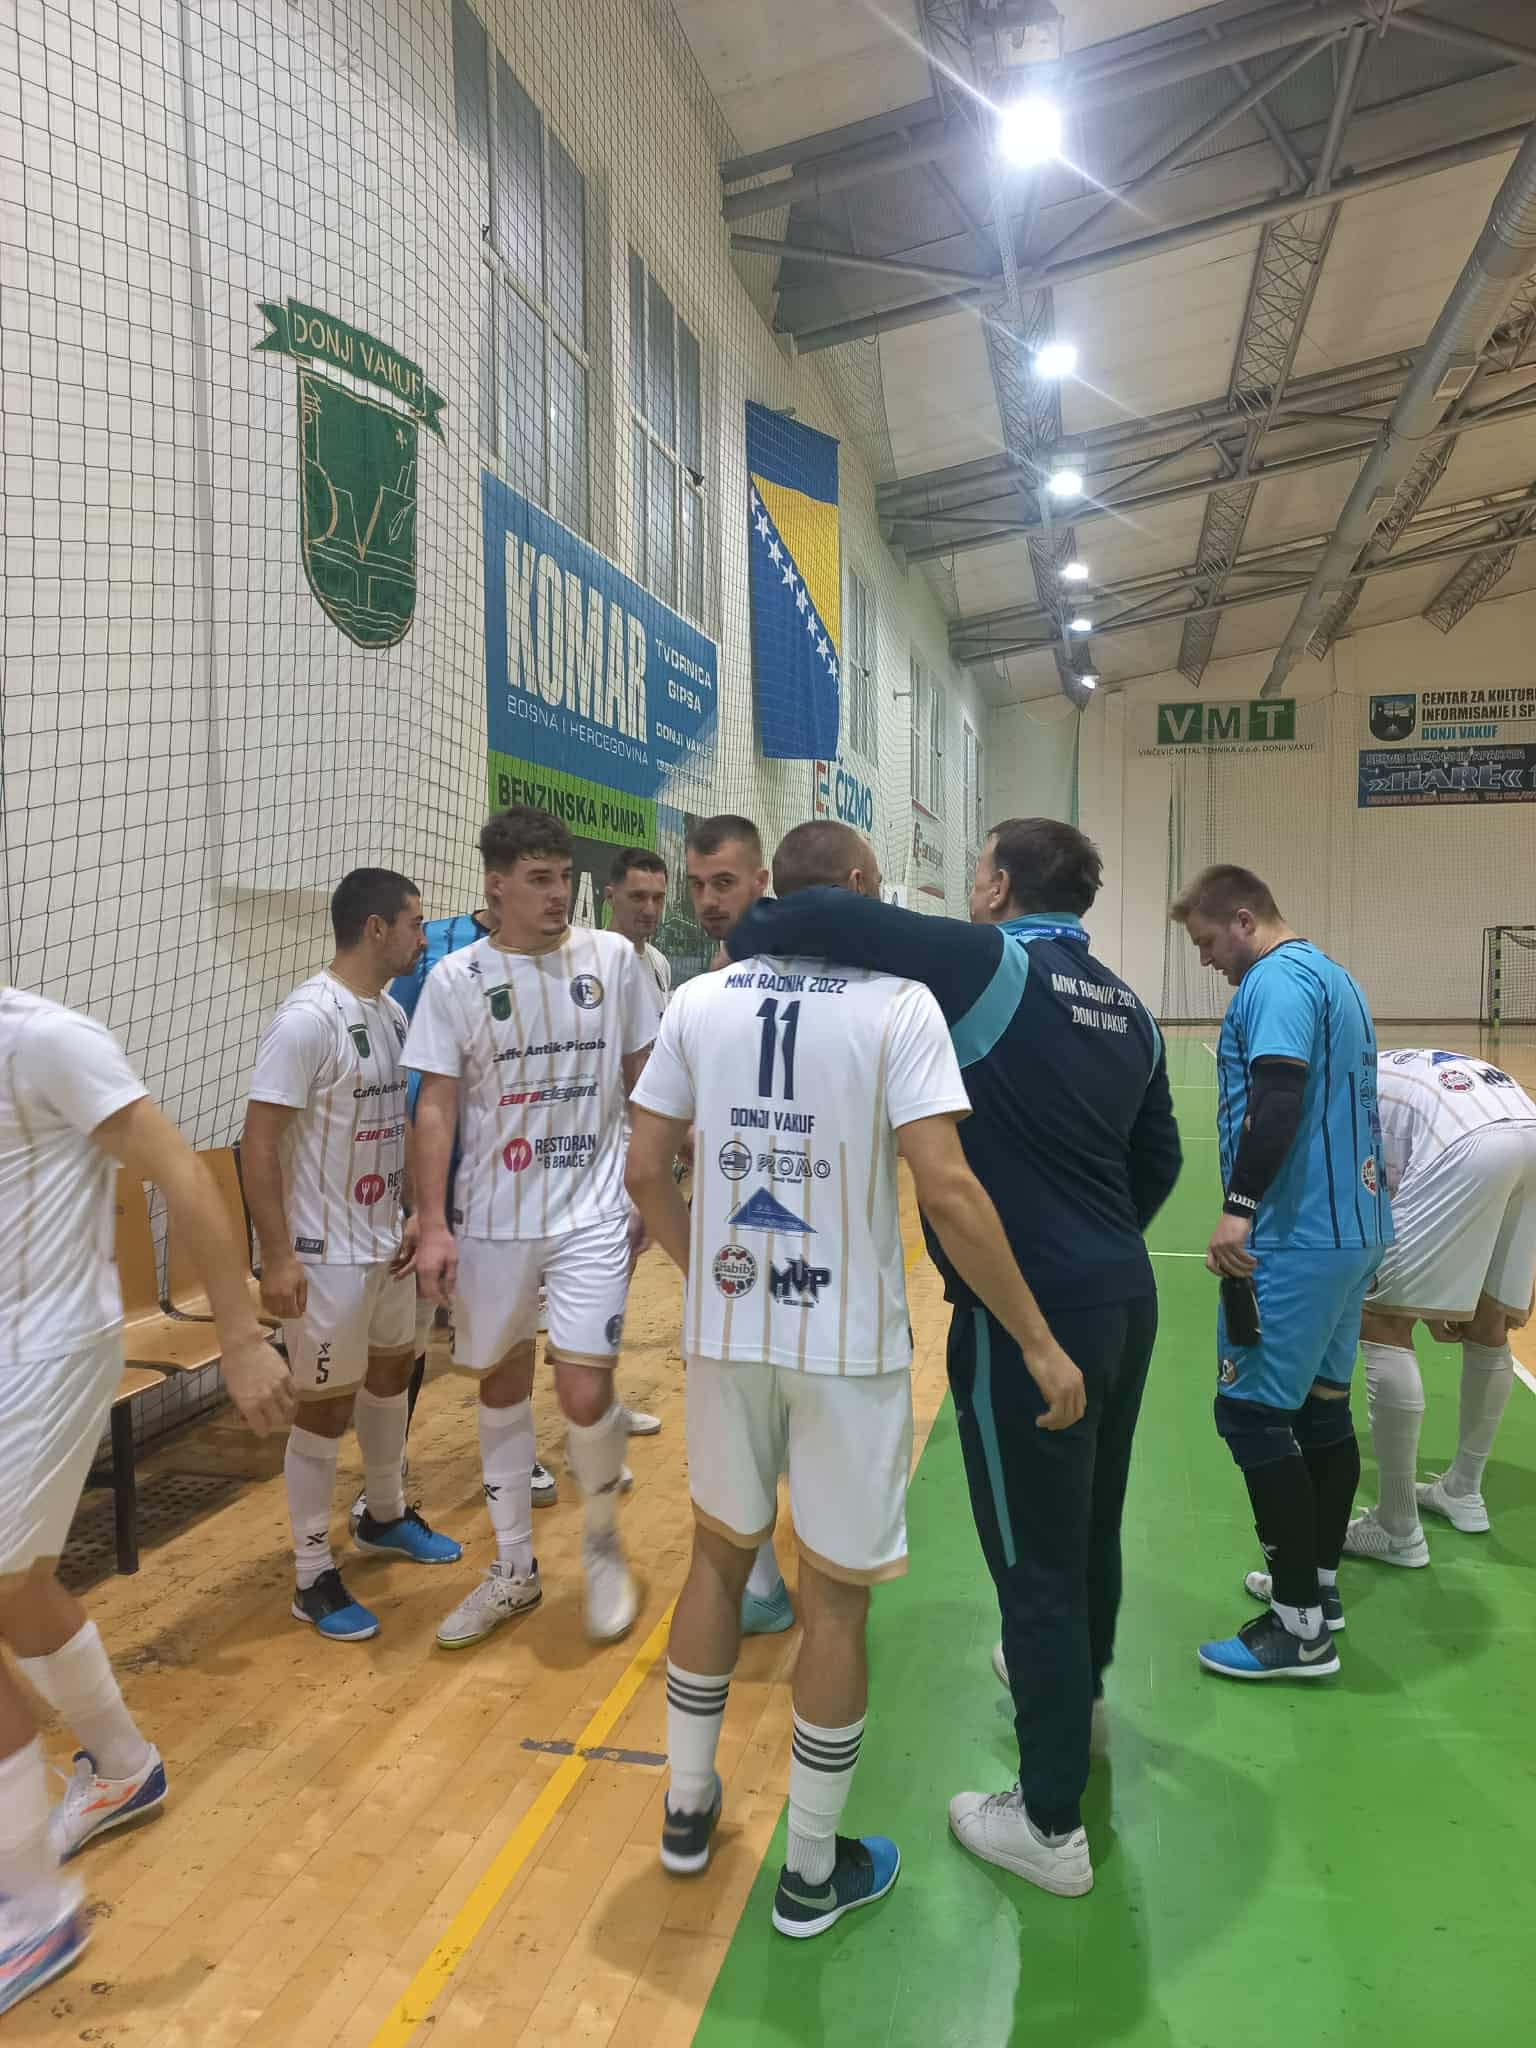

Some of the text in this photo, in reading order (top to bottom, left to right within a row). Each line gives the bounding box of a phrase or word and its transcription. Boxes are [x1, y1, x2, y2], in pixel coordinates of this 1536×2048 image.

[294, 312, 421, 399] DONJI VAKUF
[505, 529, 648, 744] KOMAR
[656, 637, 712, 690] TVORNICA
[668, 679, 702, 713] GIPSA
[1422, 687, 1536, 706] CENTAR ZA KULTUR
[1164, 704, 1285, 741] VMT
[1422, 705, 1509, 721] INFORMISANJE
[1512, 704, 1517, 717] I
[507, 695, 648, 767] BOSNA I HERCEGOVINA
[656, 721, 684, 747] DONJI
[1422, 725, 1498, 741] DONJI VAKUF
[498, 774, 646, 838] BENZINSKA PUMPA
[725, 973, 848, 994] MNK RADNIK 2022
[1051, 973, 1079, 997] MNK
[1079, 980, 1116, 1005] RADNIK
[1072, 1005, 1128, 1034] DONJI VAKUF
[756, 998, 801, 1100] 11
[353, 1085, 381, 1098] Caffe
[731, 1107, 816, 1134] DONJI VAKUF
[535, 1134, 597, 1155] RESTORAN
[756, 1153, 832, 1179] PROMO
[720, 1264, 751, 1274] Habib
[769, 1256, 832, 1302] MVP
[316, 1357, 331, 1385] 5
